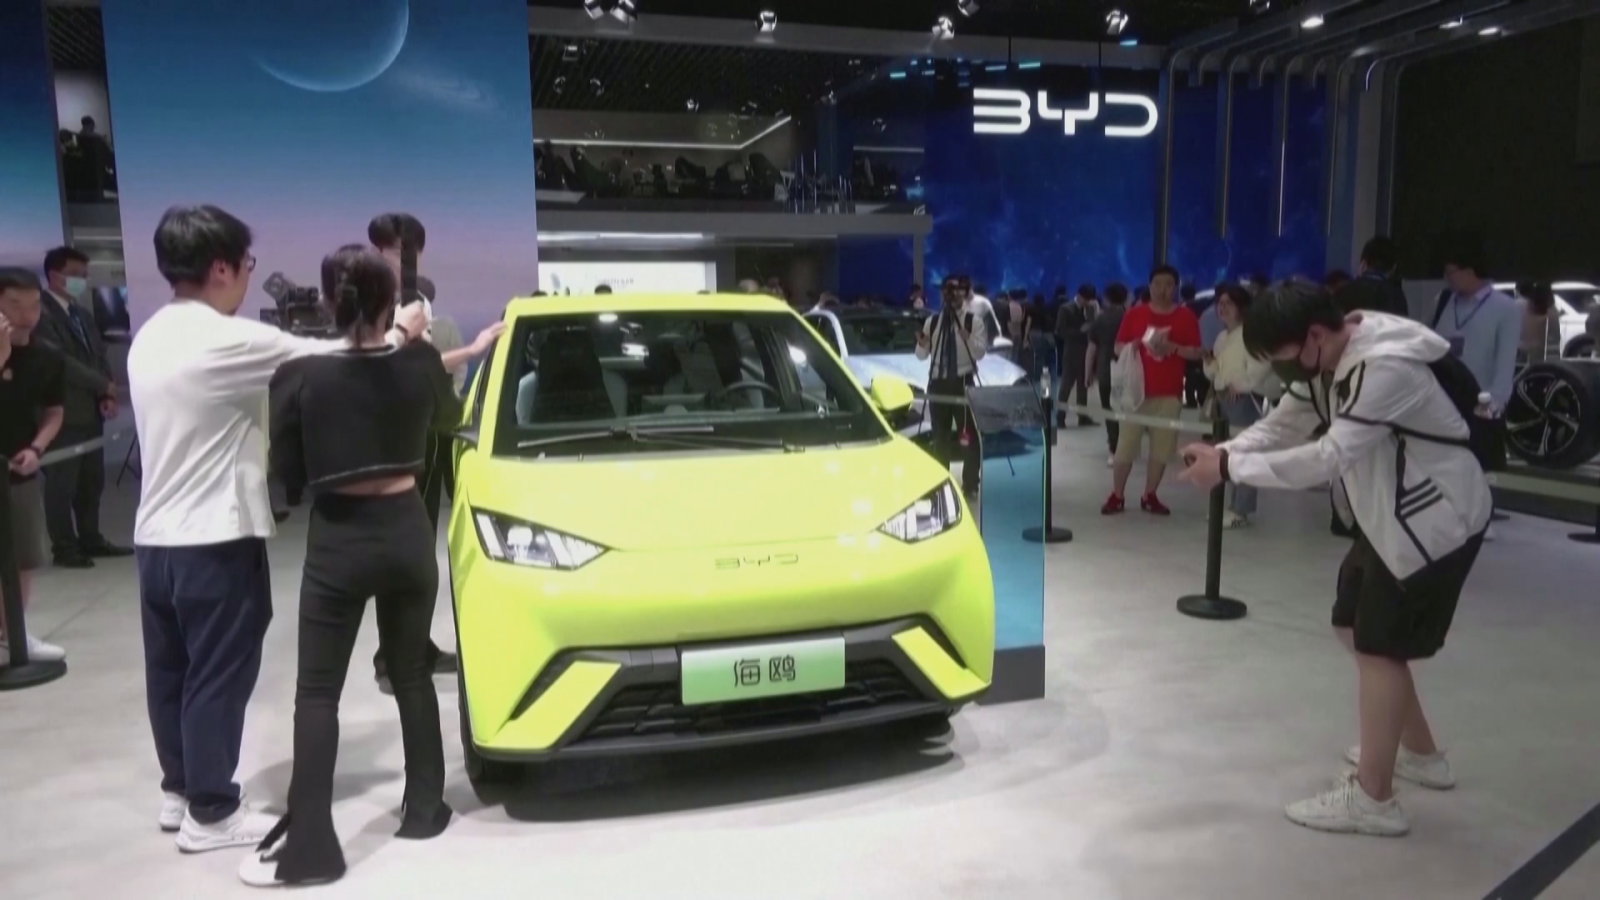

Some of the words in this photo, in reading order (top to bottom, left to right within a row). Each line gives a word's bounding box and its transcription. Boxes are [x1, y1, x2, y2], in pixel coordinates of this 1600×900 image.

[973, 88, 1158, 137] BYD
[715, 553, 799, 570] BYD
[733, 653, 796, 688] 海鸥
